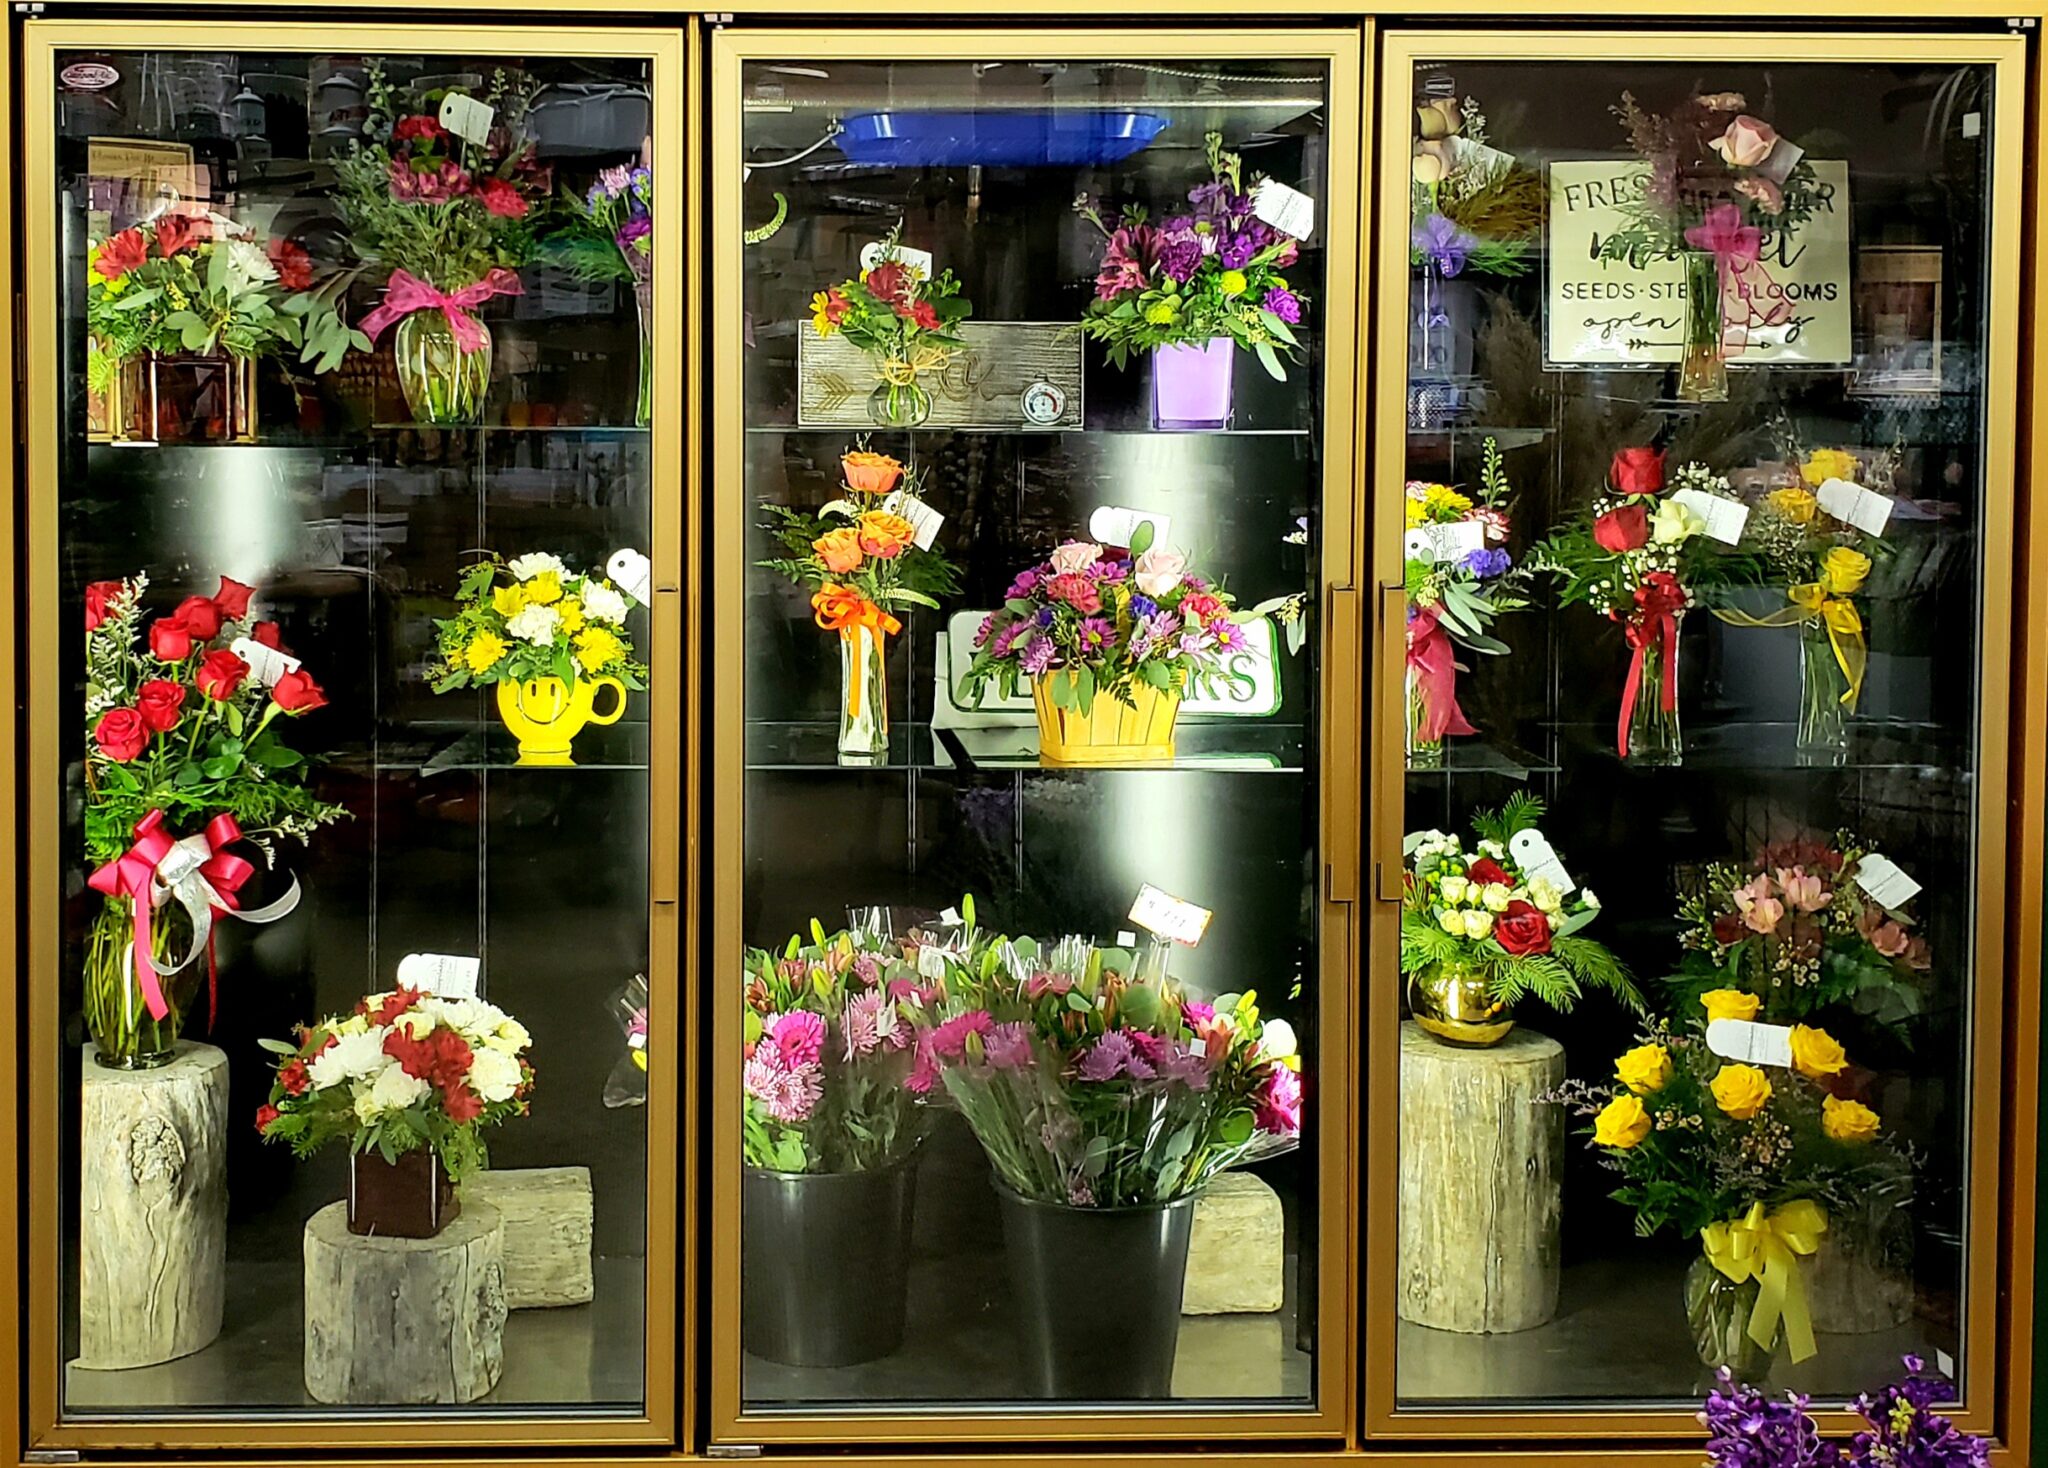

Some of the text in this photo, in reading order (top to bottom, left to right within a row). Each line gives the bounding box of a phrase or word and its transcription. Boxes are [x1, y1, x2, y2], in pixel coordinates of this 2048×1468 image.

[1563, 174, 1656, 212] FRES
[1561, 282, 1636, 300] SEEDS
[1648, 282, 1688, 300] STE
[1582, 311, 1682, 340] open
